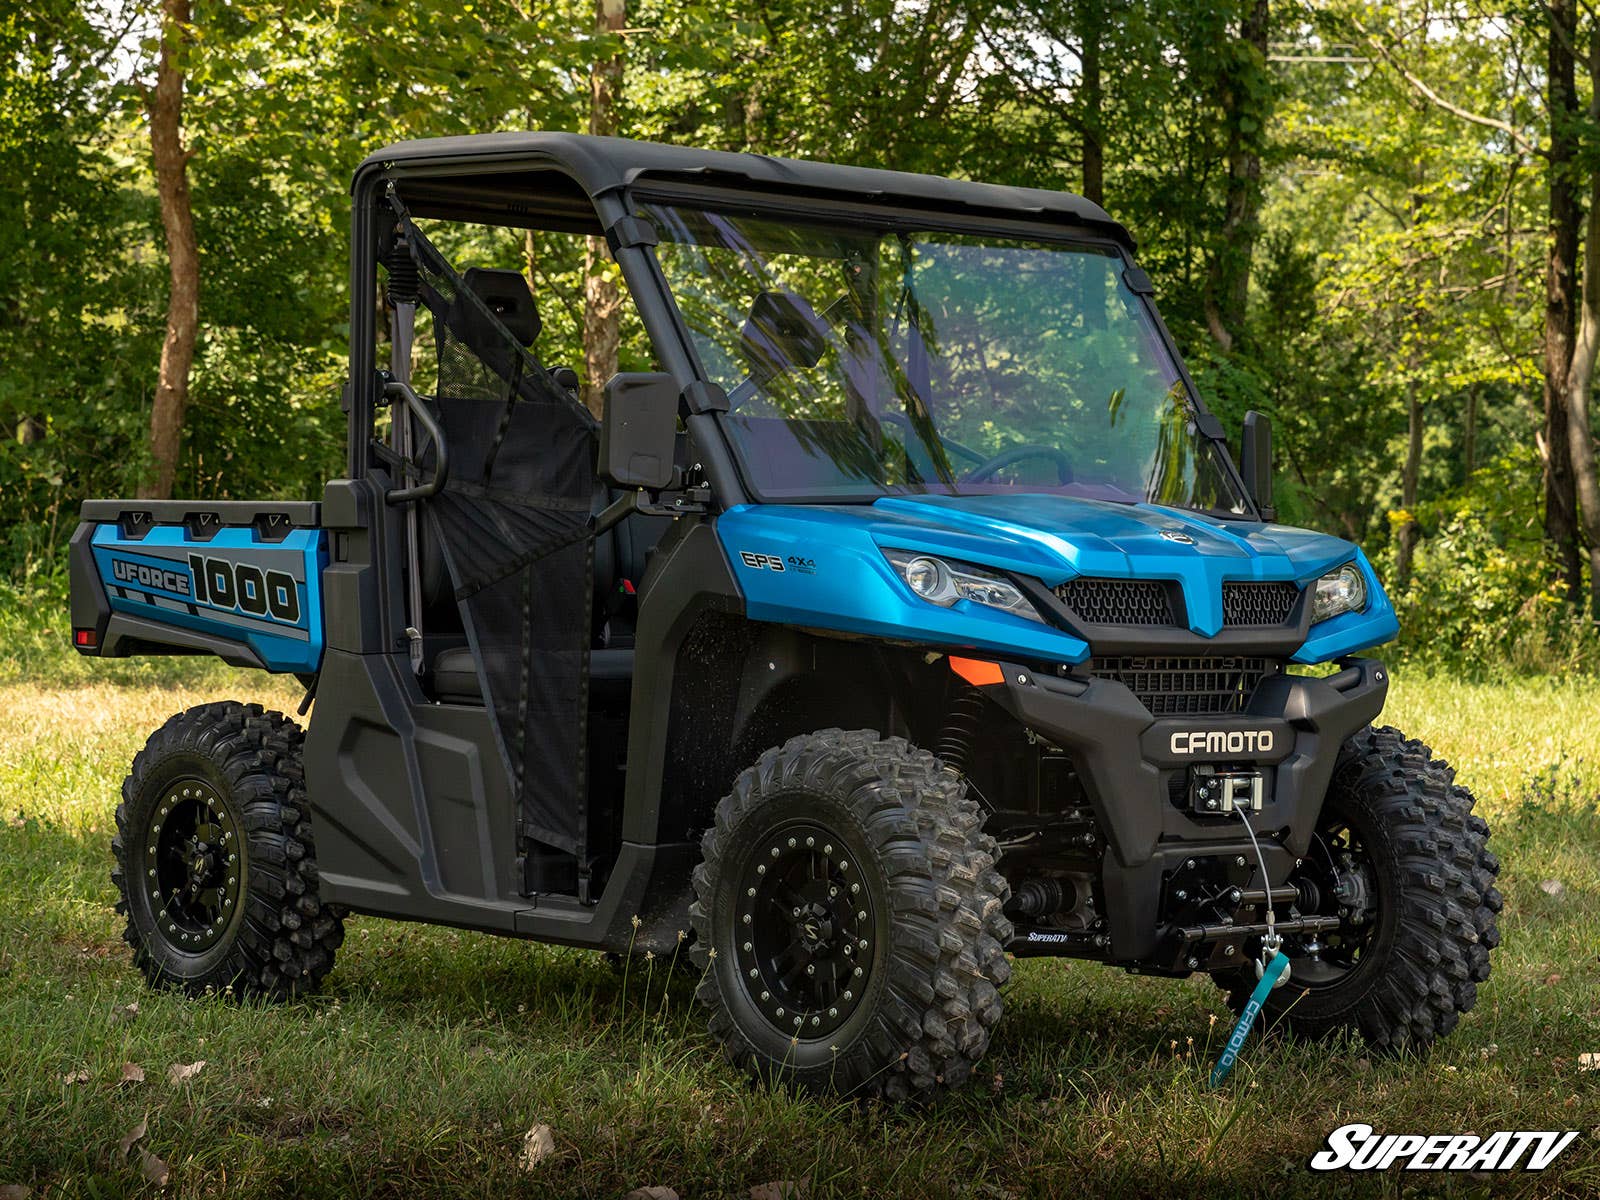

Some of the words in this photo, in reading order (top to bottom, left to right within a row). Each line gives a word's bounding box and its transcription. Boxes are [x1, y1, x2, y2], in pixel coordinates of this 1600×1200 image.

[740, 551, 785, 572] EPS
[112, 559, 189, 595] UFORCE
[188, 552, 300, 624] 1000
[1170, 730, 1274, 754] CFMOTO
[1221, 1000, 1260, 1067] CFMOTO
